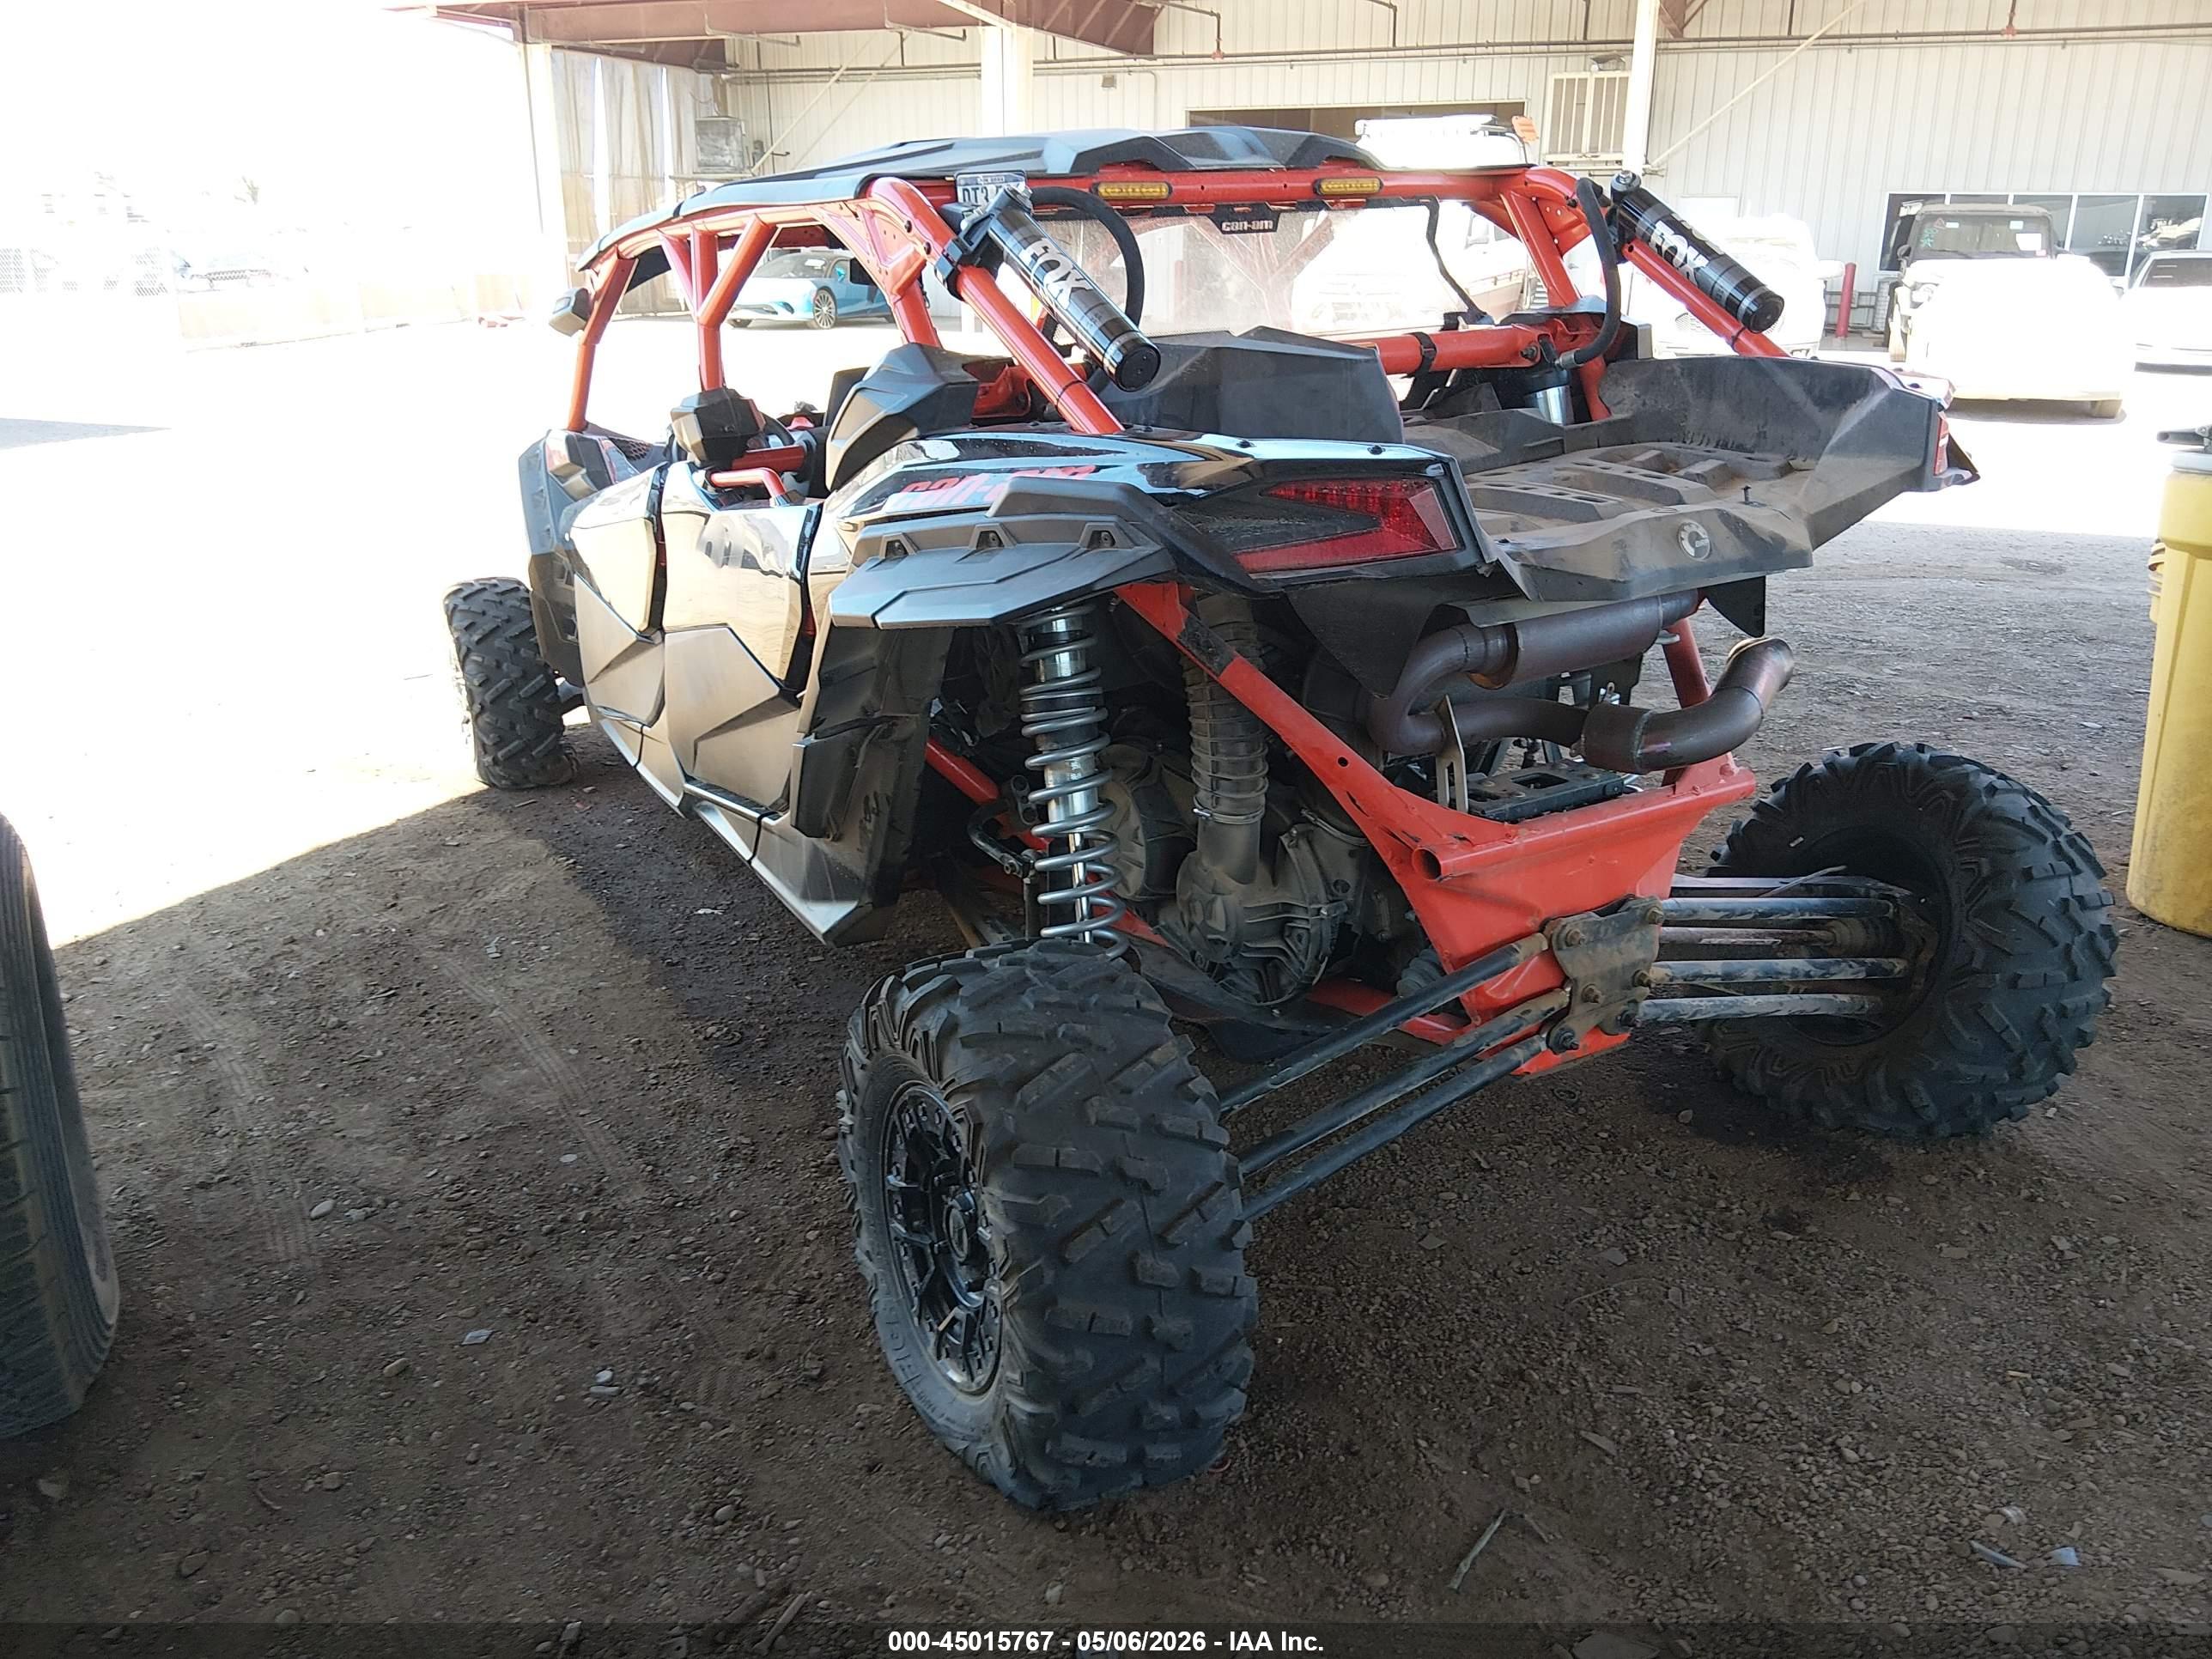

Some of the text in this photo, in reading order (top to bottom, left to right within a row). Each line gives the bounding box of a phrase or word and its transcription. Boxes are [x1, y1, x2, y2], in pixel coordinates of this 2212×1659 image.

[1221, 220, 1273, 233] can-am
[1648, 220, 1710, 286] FOX
[1020, 238, 1093, 310] FOX
